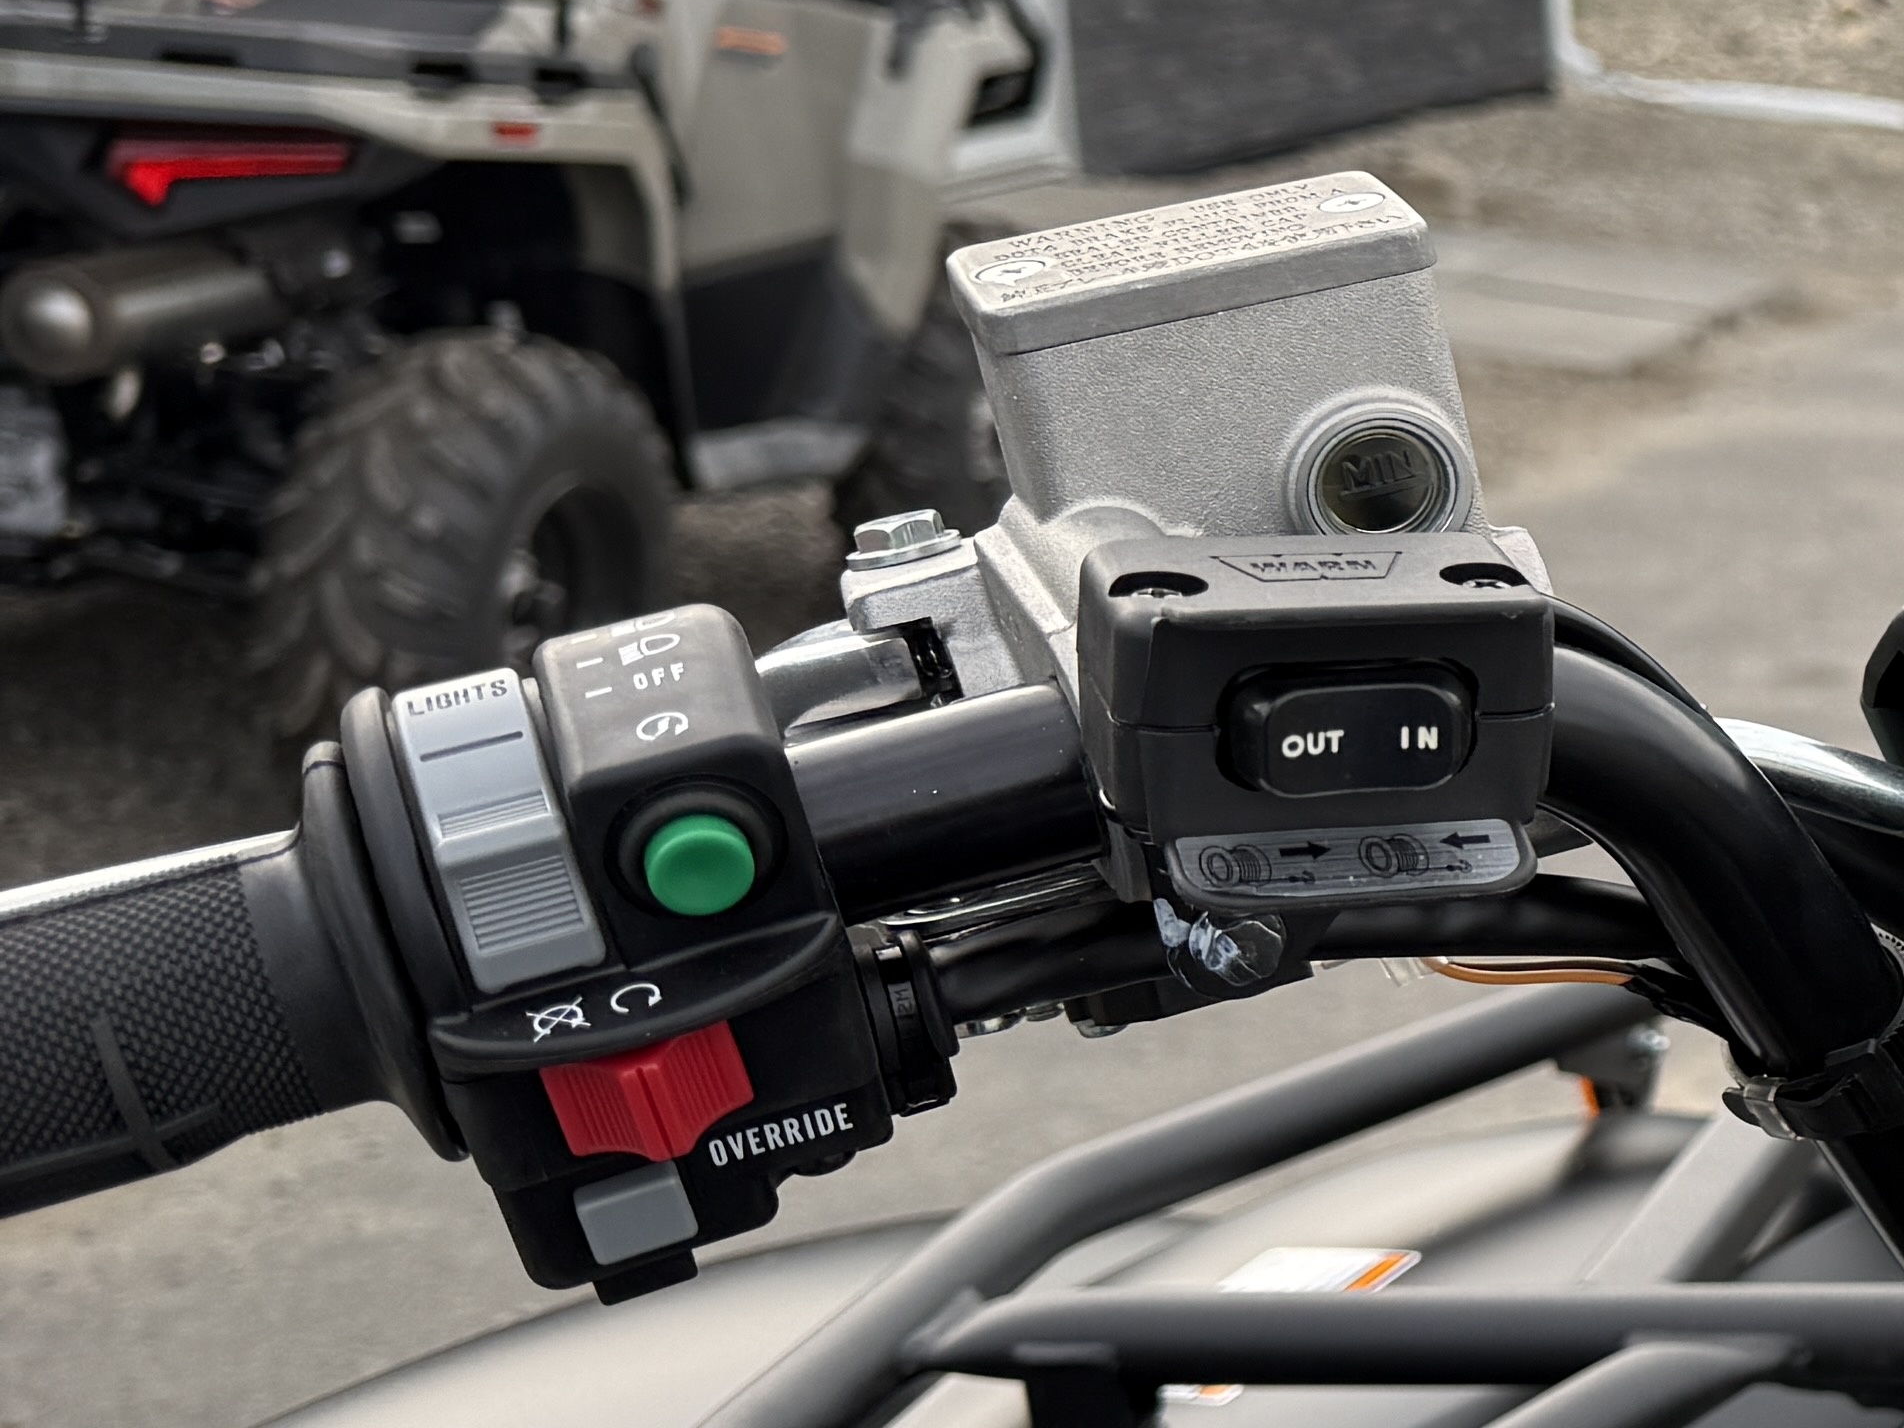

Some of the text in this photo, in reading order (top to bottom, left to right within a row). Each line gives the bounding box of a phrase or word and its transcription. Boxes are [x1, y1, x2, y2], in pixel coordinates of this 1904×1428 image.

[1008, 212, 1157, 250] WARNING
[1342, 448, 1414, 489] MIN
[633, 663, 684, 690] OFF
[407, 679, 508, 717] LIGHTS
[1282, 726, 1438, 758] OUT IN
[709, 1103, 853, 1166] OVERRIDE
